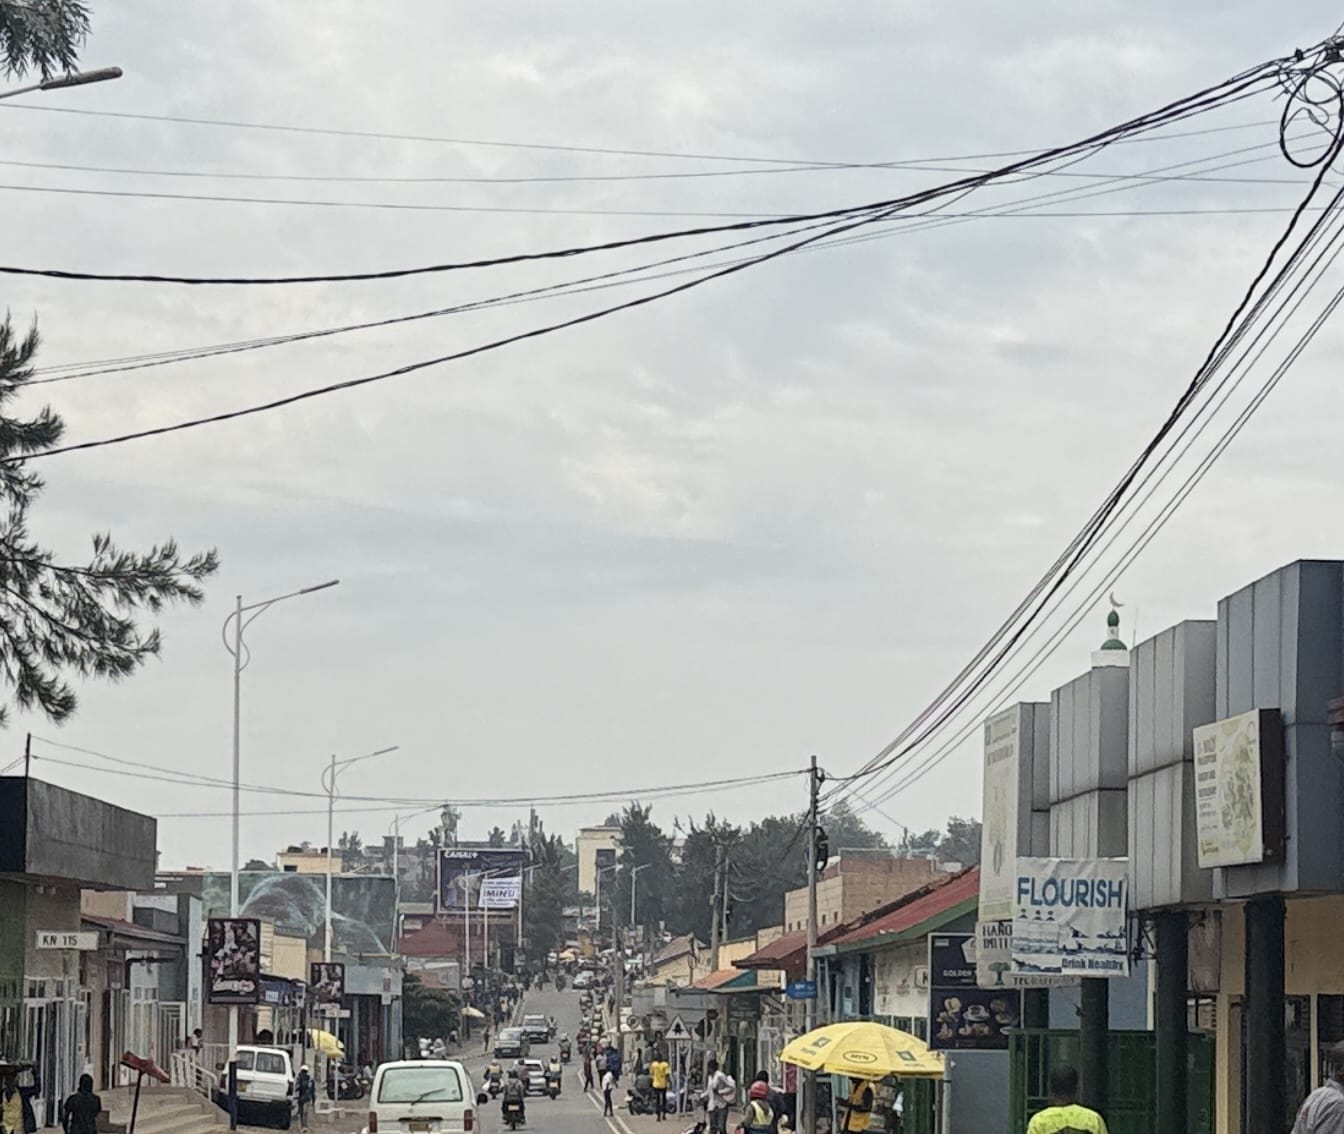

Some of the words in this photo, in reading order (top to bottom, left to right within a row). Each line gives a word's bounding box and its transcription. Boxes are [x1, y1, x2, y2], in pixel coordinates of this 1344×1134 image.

[1017, 876, 1122, 908] FLOURISH
[43, 935, 57, 945] KN
[63, 935, 78, 946] 115
